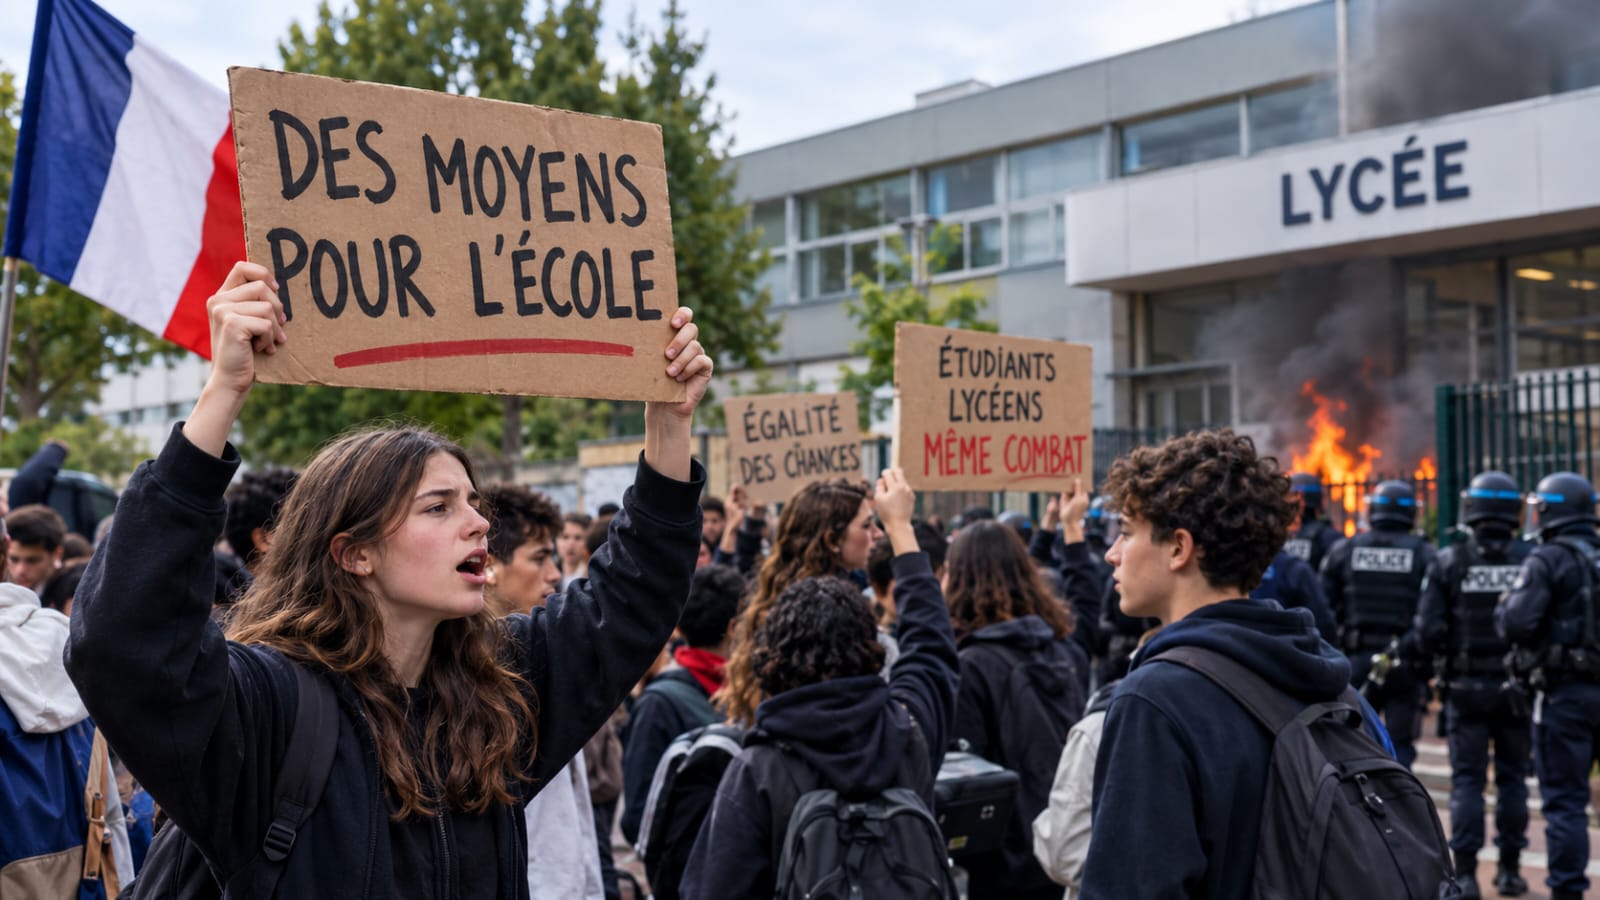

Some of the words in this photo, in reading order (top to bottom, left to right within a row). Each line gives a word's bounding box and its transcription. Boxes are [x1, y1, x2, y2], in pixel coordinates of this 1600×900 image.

[269, 109, 397, 204] DES
[422, 132, 647, 227] MOYENS
[1281, 135, 1470, 226] LYCÉE
[266, 227, 436, 321] POUR
[469, 230, 663, 321] L'ÉCOLE
[949, 382, 1043, 422] LYCÉENS
[739, 453, 776, 485] DES
[924, 427, 993, 477] MÊME
[1004, 434, 1088, 475] COMBAT
[1357, 551, 1406, 569] POLICE
